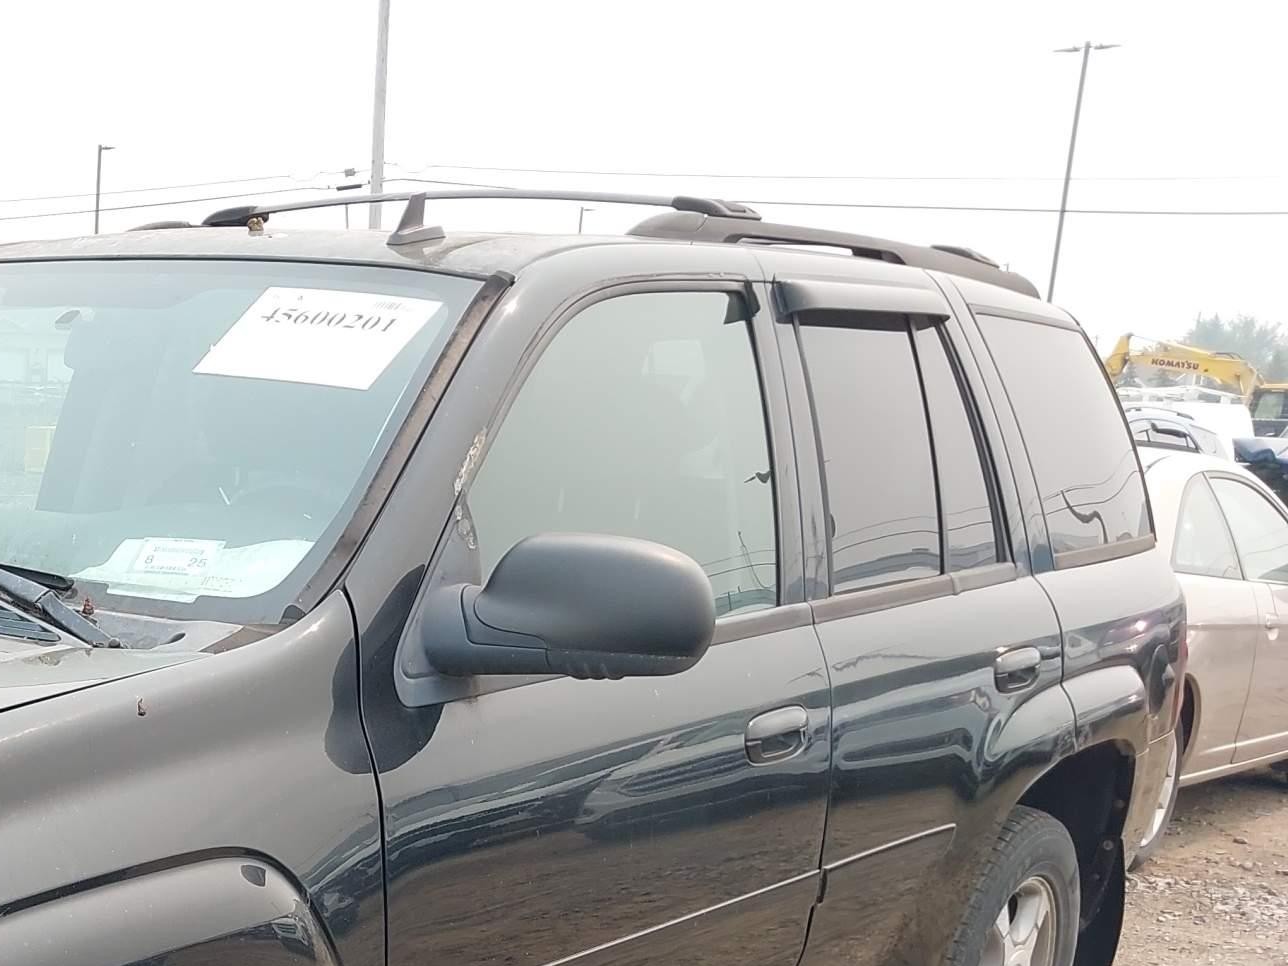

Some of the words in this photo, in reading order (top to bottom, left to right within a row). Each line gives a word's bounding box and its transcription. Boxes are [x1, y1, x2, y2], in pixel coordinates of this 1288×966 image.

[261, 307, 398, 332] 45600201
[1151, 358, 1199, 370] KOMATSU
[187, 557, 208, 569] 25
